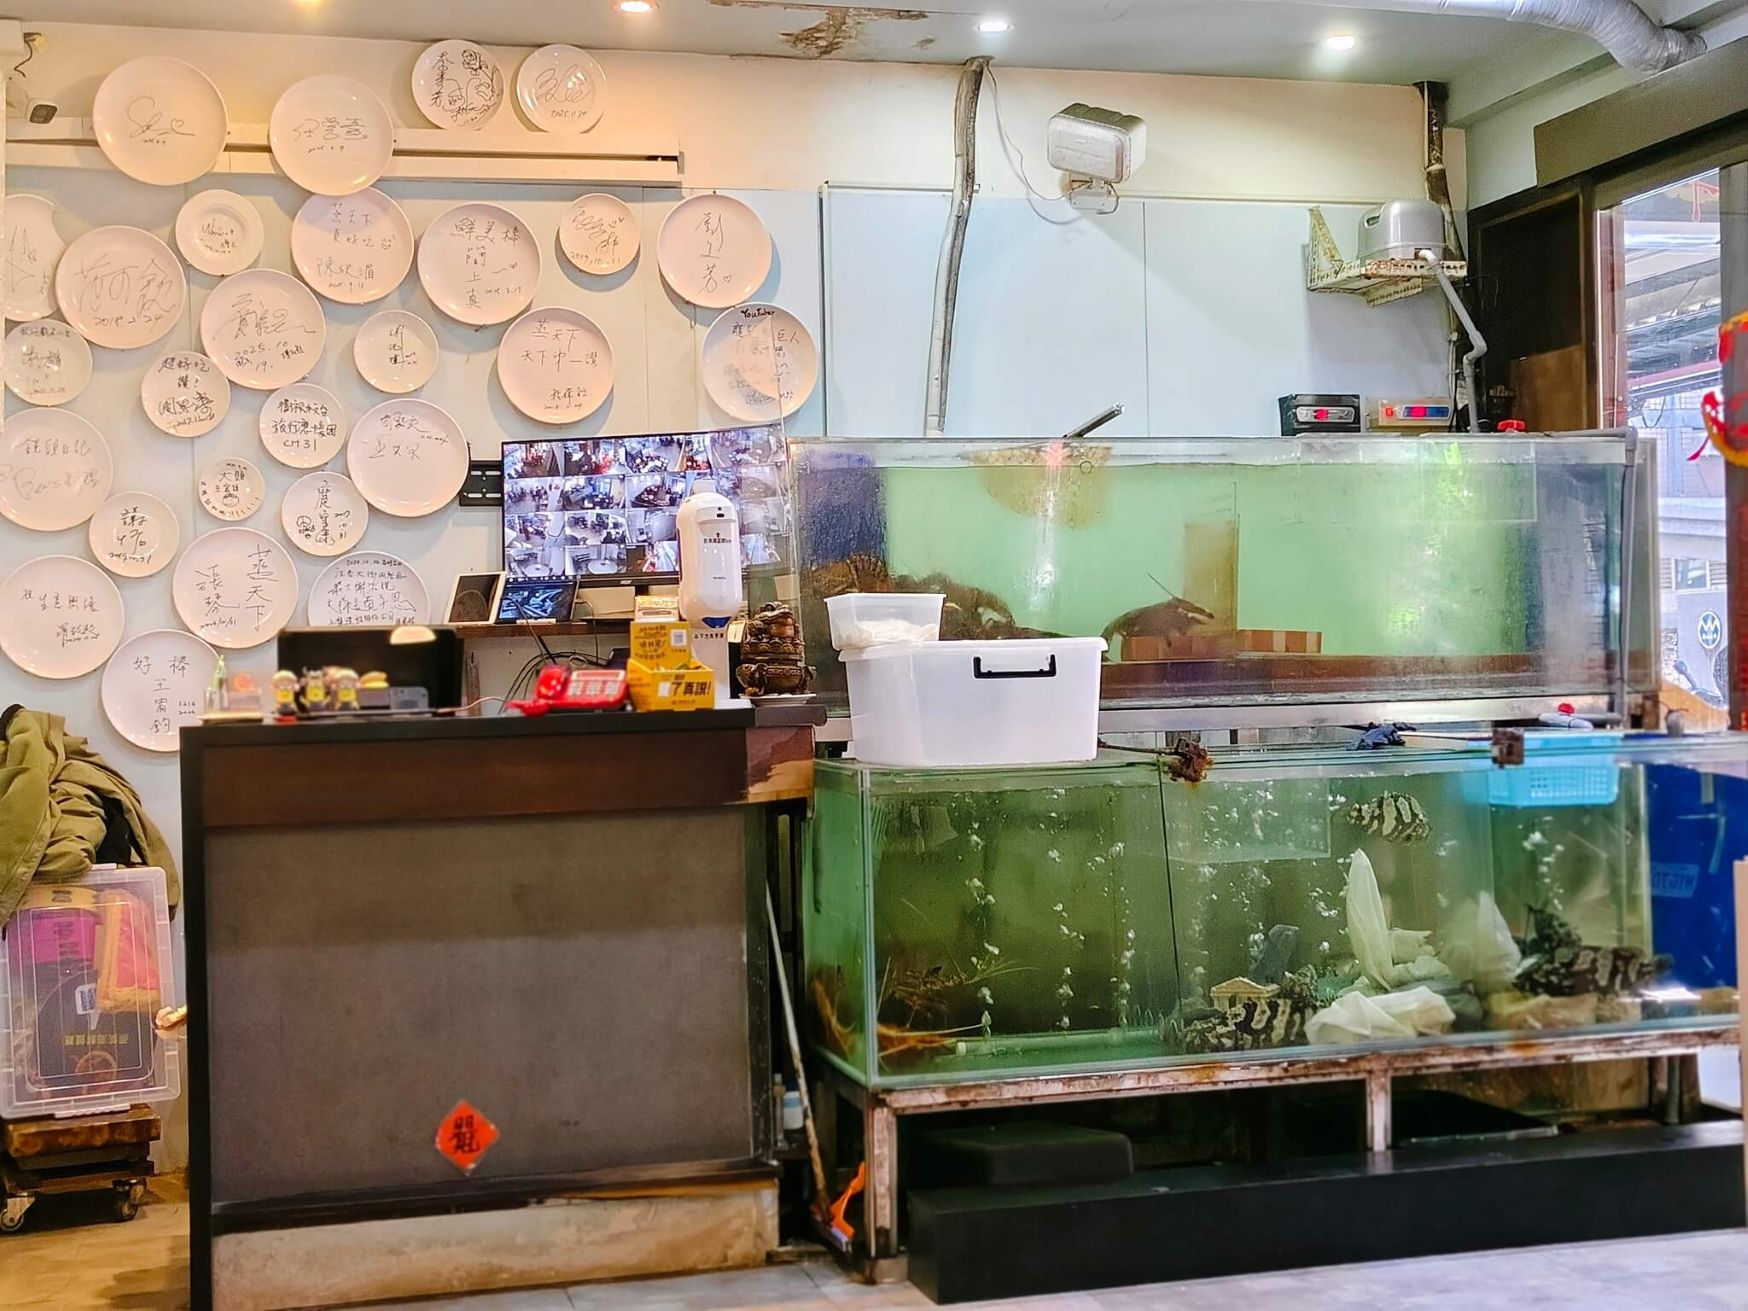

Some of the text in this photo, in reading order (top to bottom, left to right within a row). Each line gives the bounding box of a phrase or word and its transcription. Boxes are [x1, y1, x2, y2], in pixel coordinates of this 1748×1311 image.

[740, 307, 776, 319] YouTuber
[245, 543, 279, 632] 蒸天下
